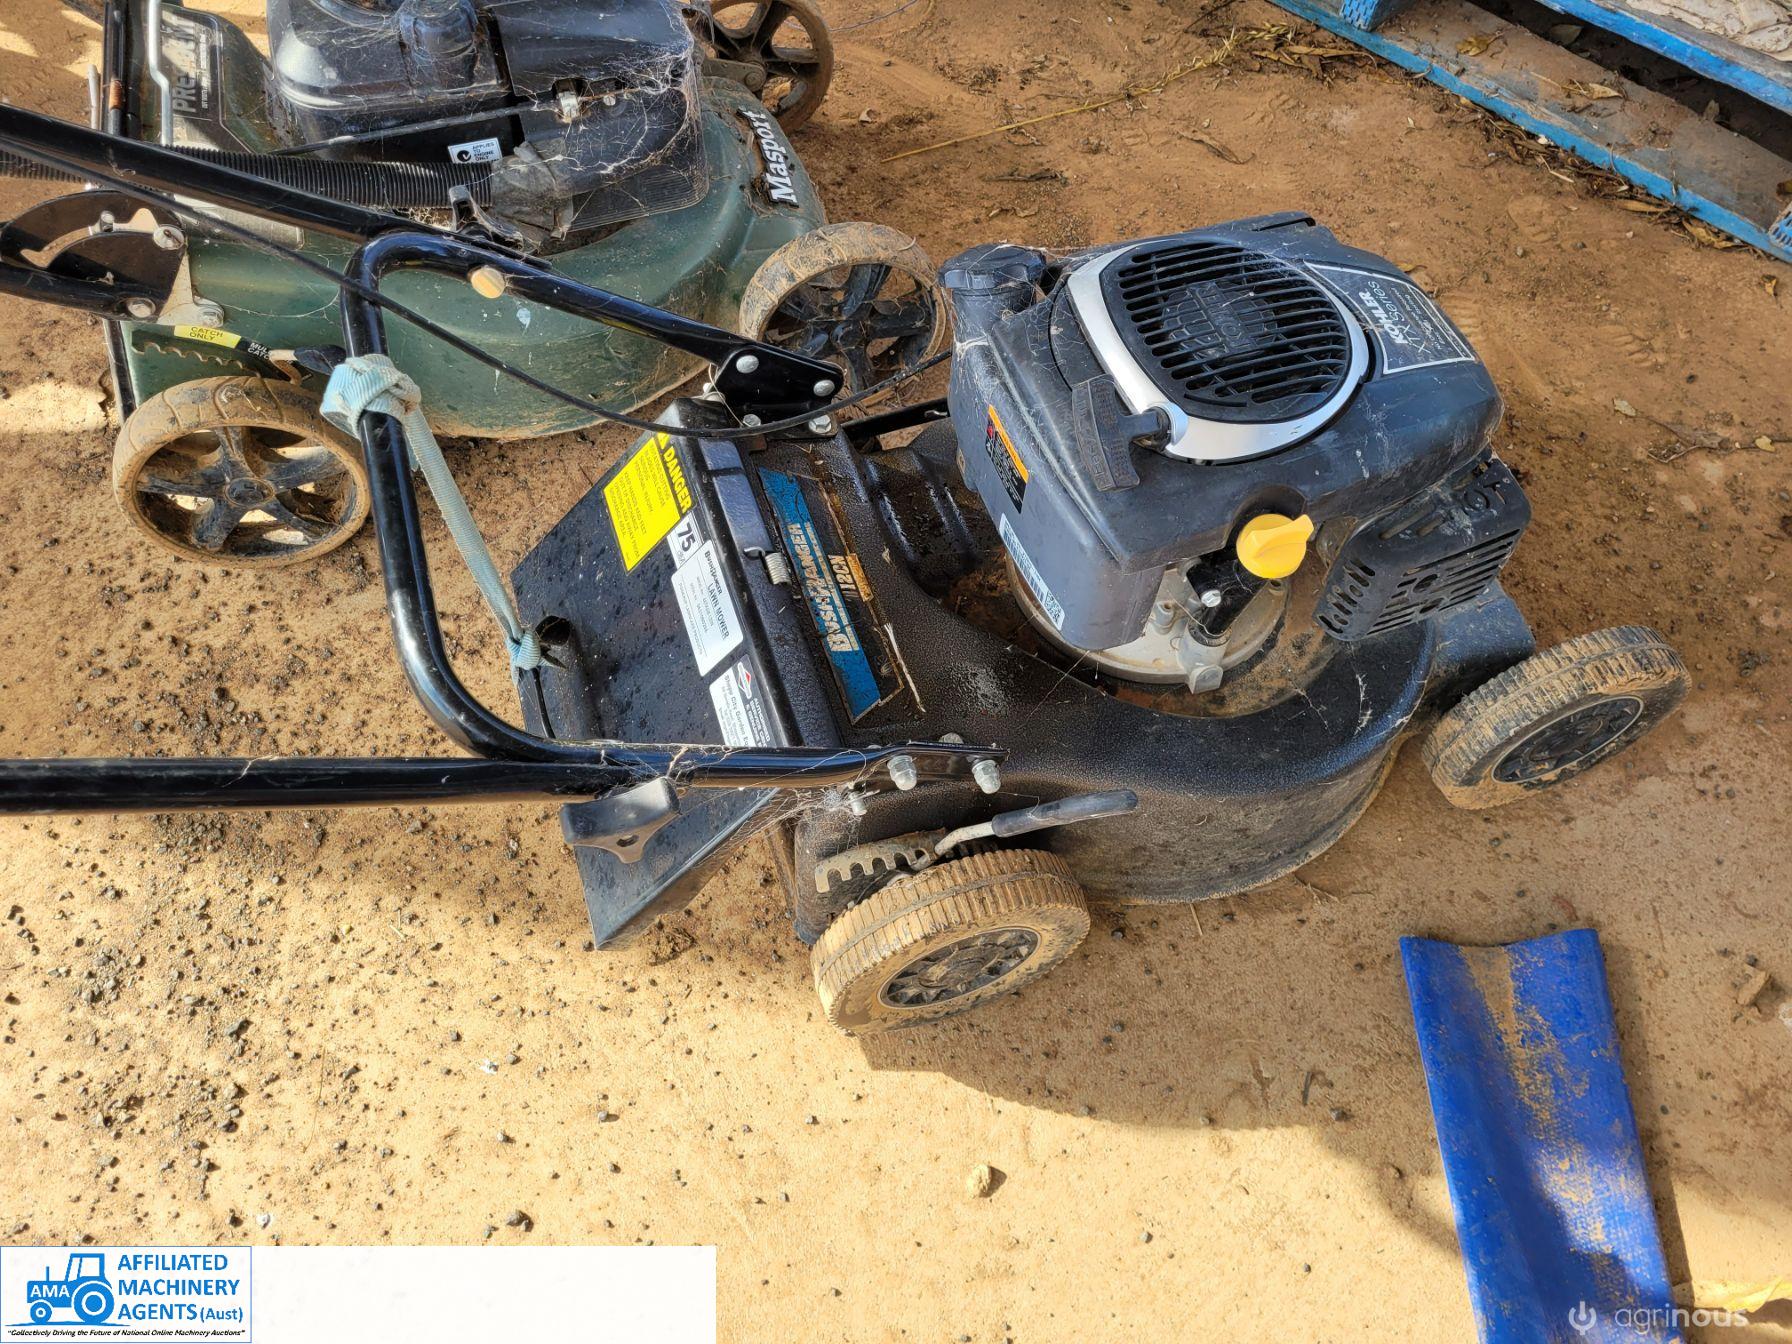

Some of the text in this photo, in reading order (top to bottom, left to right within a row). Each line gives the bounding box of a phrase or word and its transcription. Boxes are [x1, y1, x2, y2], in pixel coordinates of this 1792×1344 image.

[738, 107, 798, 204] Masport
[1359, 291, 1408, 344] KOHLER
[1368, 281, 1405, 321] Series
[188, 330, 215, 342] ONLY
[190, 325, 223, 338] CATCH
[247, 347, 270, 360] CATC
[663, 446, 692, 514] DANGER
[677, 522, 696, 552] 75
[706, 581, 720, 609] LAWN
[714, 605, 730, 640] MOWER
